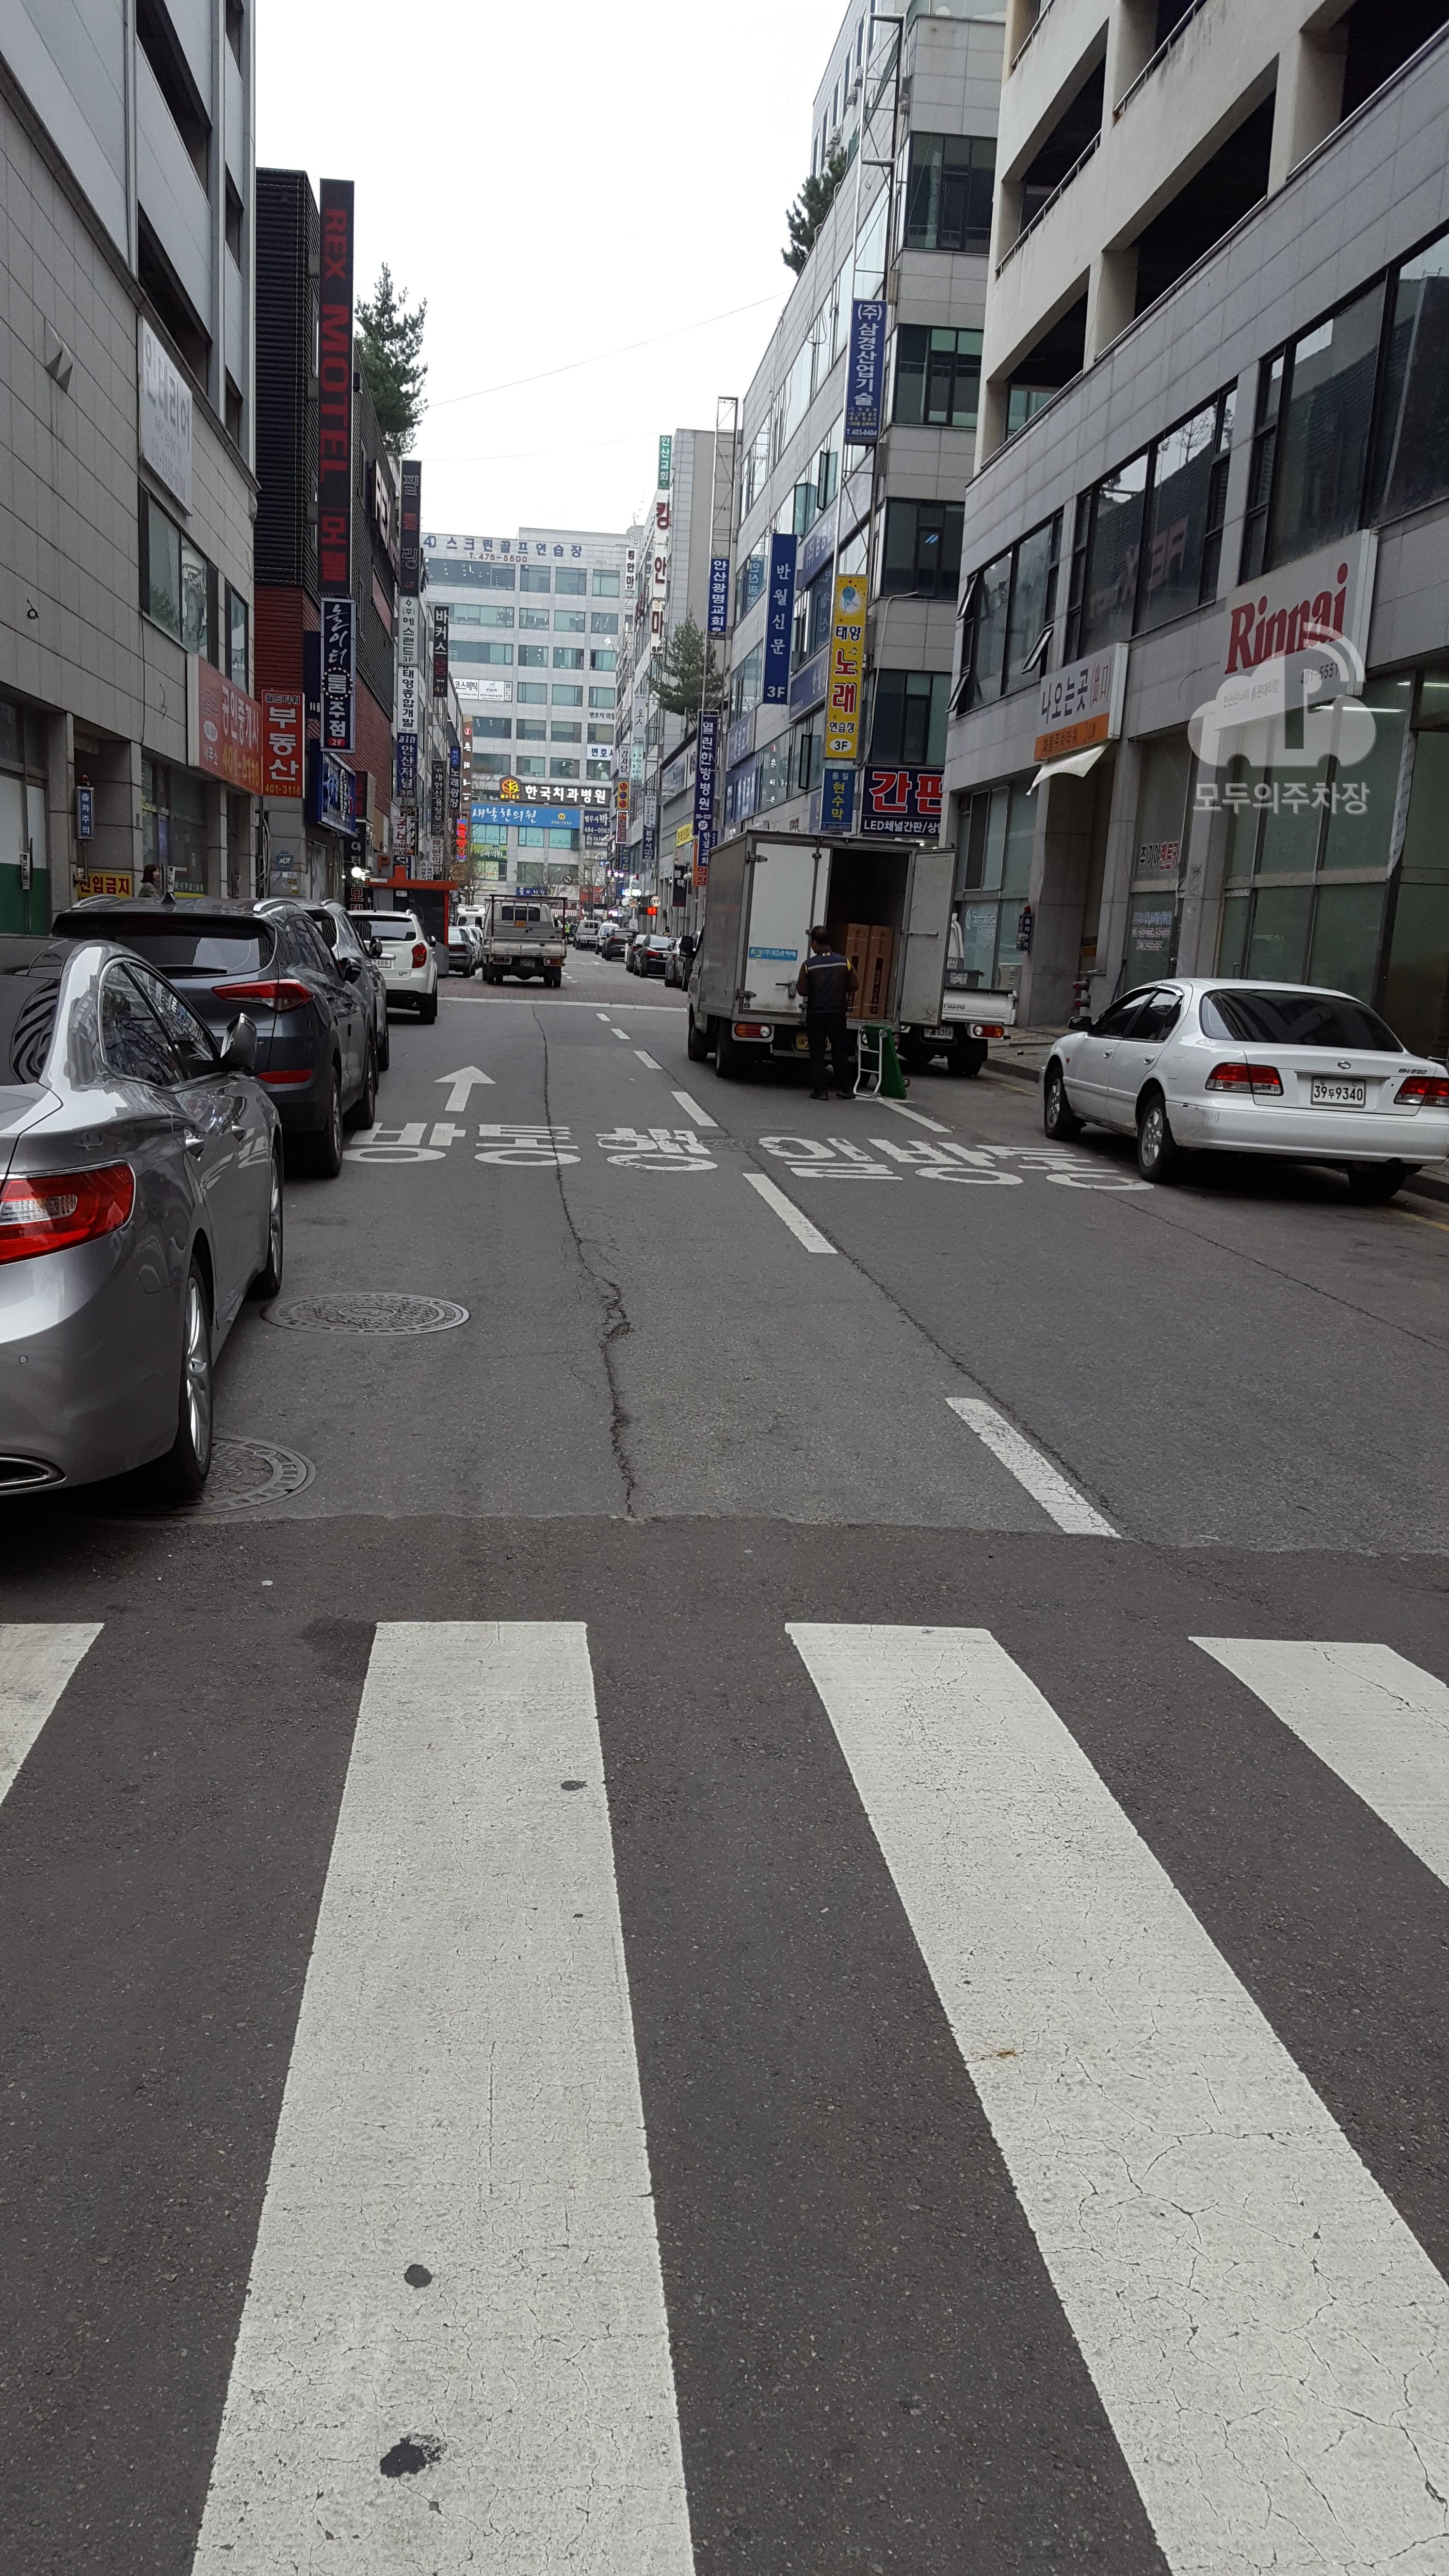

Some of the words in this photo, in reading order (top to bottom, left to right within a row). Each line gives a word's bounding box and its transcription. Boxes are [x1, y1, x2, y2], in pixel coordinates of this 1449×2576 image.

[323, 208, 348, 281] REX
[320, 304, 350, 484] MOTEL
[660, 437, 671, 481] 안산교회
[710, 560, 727, 626] 안산광명교회
[771, 564, 791, 655] 반월신문
[325, 603, 350, 666] 놀이터
[435, 609, 448, 655] 바커스
[836, 625, 861, 642] 태양
[1224, 562, 1349, 675] Rinnai
[264, 693, 301, 706] 월드타워
[402, 669, 415, 728] 태영종합개발
[454, 681, 478, 692] 코스메틱
[767, 686, 785, 698] 3F
[832, 647, 858, 714] 노래
[222, 684, 259, 754] 공인중개사
[328, 701, 346, 738] 주점
[829, 721, 855, 734] 연습장
[268, 706, 300, 782] 부동산
[331, 739, 343, 747] 2F
[620, 750, 628, 773] 감자탕
[834, 740, 848, 751] 3F
[400, 744, 416, 789] 안산저널
[698, 721, 713, 811] 열린한방병원
[264, 783, 302, 795] 401-3116
[525, 785, 606, 805] 한국치과병원
[831, 782, 845, 821] 현수막
[81, 792, 91, 835] 출차주의
[472, 806, 538, 824] 새날한의원
[863, 819, 941, 834] LED채널간판/상
[278, 857, 291, 865] ADT
[378, 855, 391, 872] P
[1313, 1085, 1363, 1101] 39두9340
